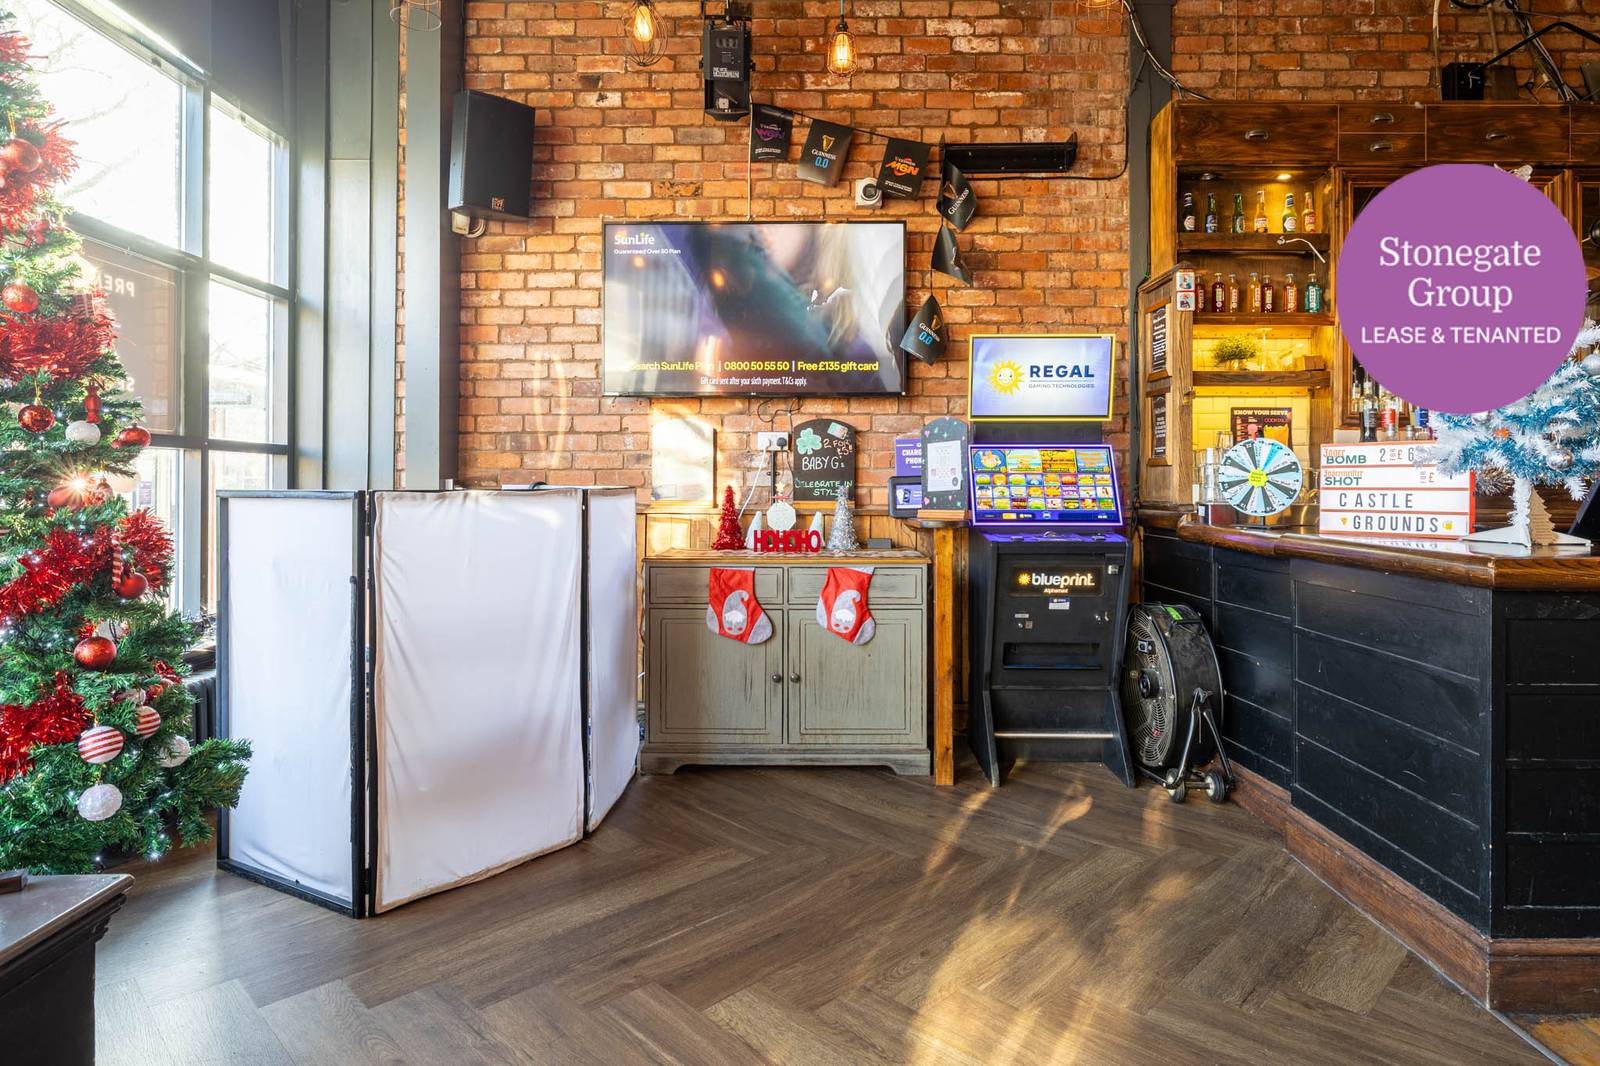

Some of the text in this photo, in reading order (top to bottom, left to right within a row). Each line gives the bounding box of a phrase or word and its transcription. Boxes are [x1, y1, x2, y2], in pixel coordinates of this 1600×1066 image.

[811, 148, 838, 160] GUINNESS
[815, 157, 829, 169] 0.0
[947, 187, 970, 215] GUINNESS
[614, 232, 655, 245] SunLife
[918, 331, 933, 345] 0.0
[919, 322, 940, 342] GUINNESS
[660, 361, 694, 371] SunLife
[724, 361, 750, 371] 0800
[751, 361, 763, 371] 50
[765, 361, 775, 371] 55
[777, 361, 790, 371] 50
[798, 361, 818, 371] Free
[818, 361, 840, 371] £135
[841, 361, 857, 373] gift
[859, 361, 879, 371] card
[1029, 364, 1095, 378] REGAL
[823, 438, 831, 449] 2
[1326, 454, 1367, 464] BOMB
[1379, 447, 1386, 463] 2
[802, 456, 829, 471] BABY
[1325, 476, 1362, 486] SHOT
[1339, 492, 1413, 509] CASTLE
[1353, 515, 1439, 533] GROUNDS
